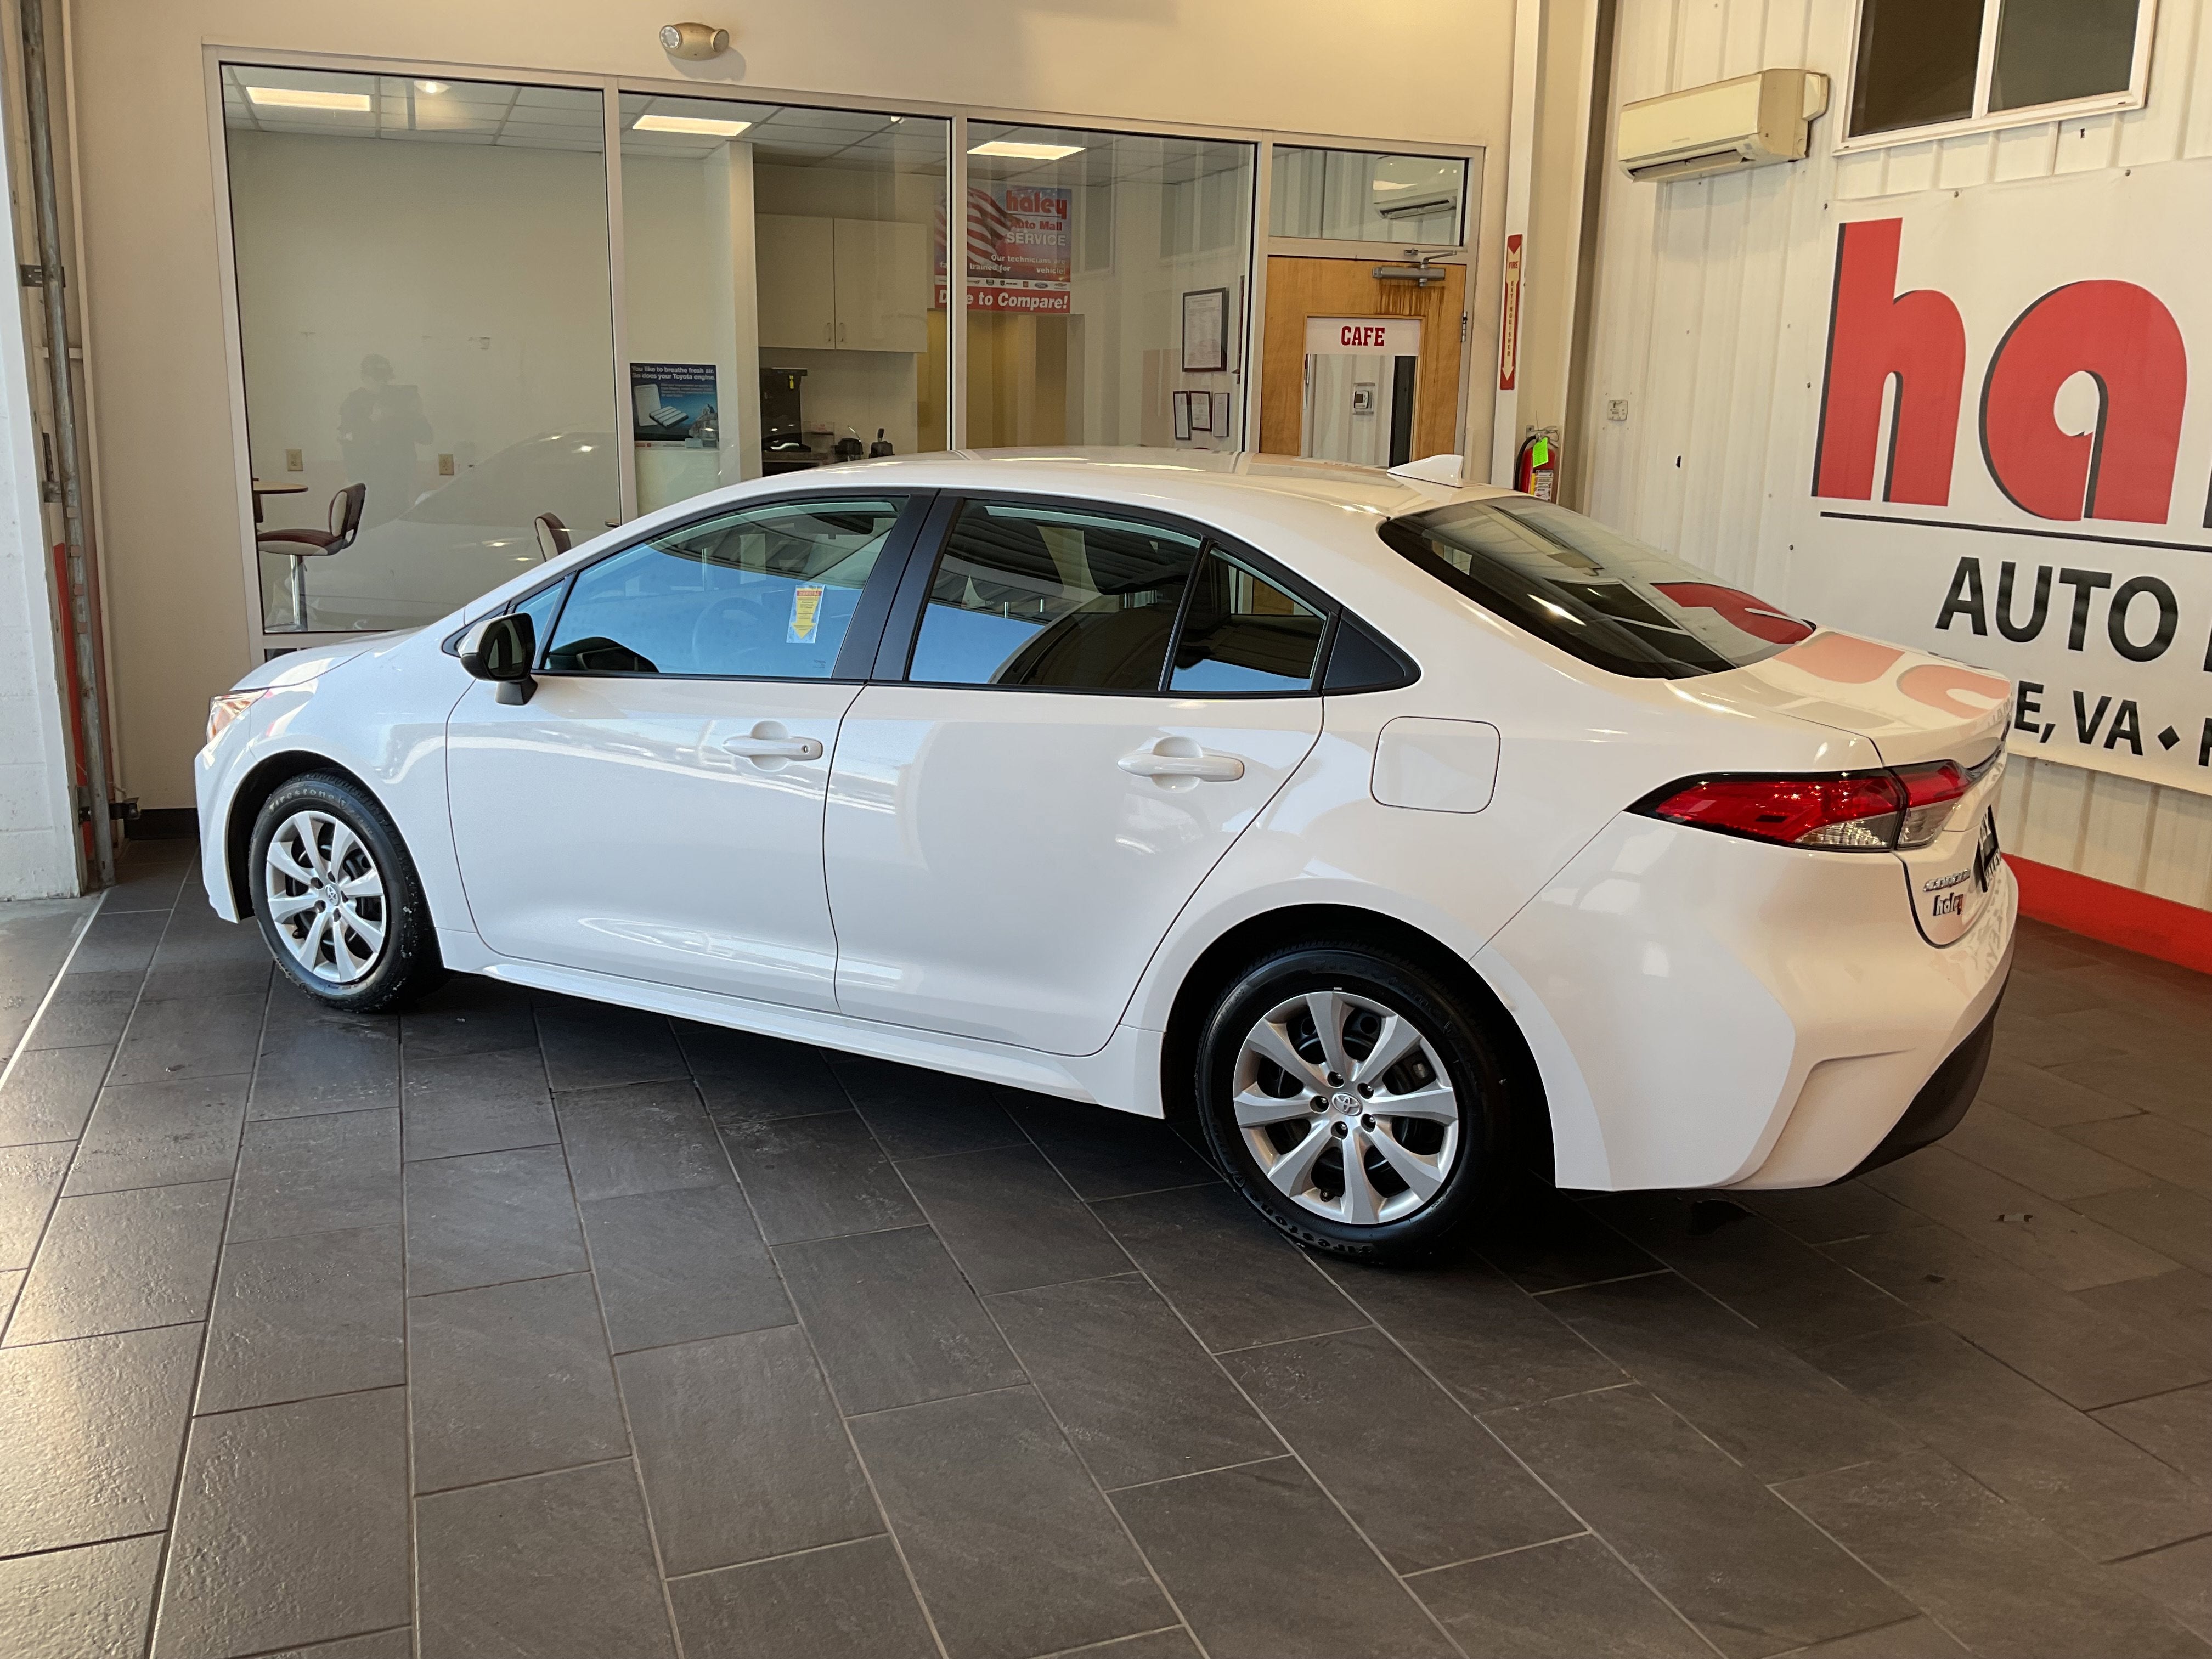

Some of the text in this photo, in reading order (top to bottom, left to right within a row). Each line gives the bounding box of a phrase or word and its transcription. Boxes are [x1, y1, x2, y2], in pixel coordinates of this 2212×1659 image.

[1006, 190, 1067, 219] haley
[1040, 221, 1063, 231] Mall
[1006, 232, 1065, 246] SERVICE
[979, 292, 993, 306] to
[998, 292, 1068, 311] Compare!
[1341, 326, 1385, 346] CAFE
[1811, 217, 2212, 528] ha
[1935, 556, 2179, 662] AUTO
[2073, 690, 2143, 756] VA
